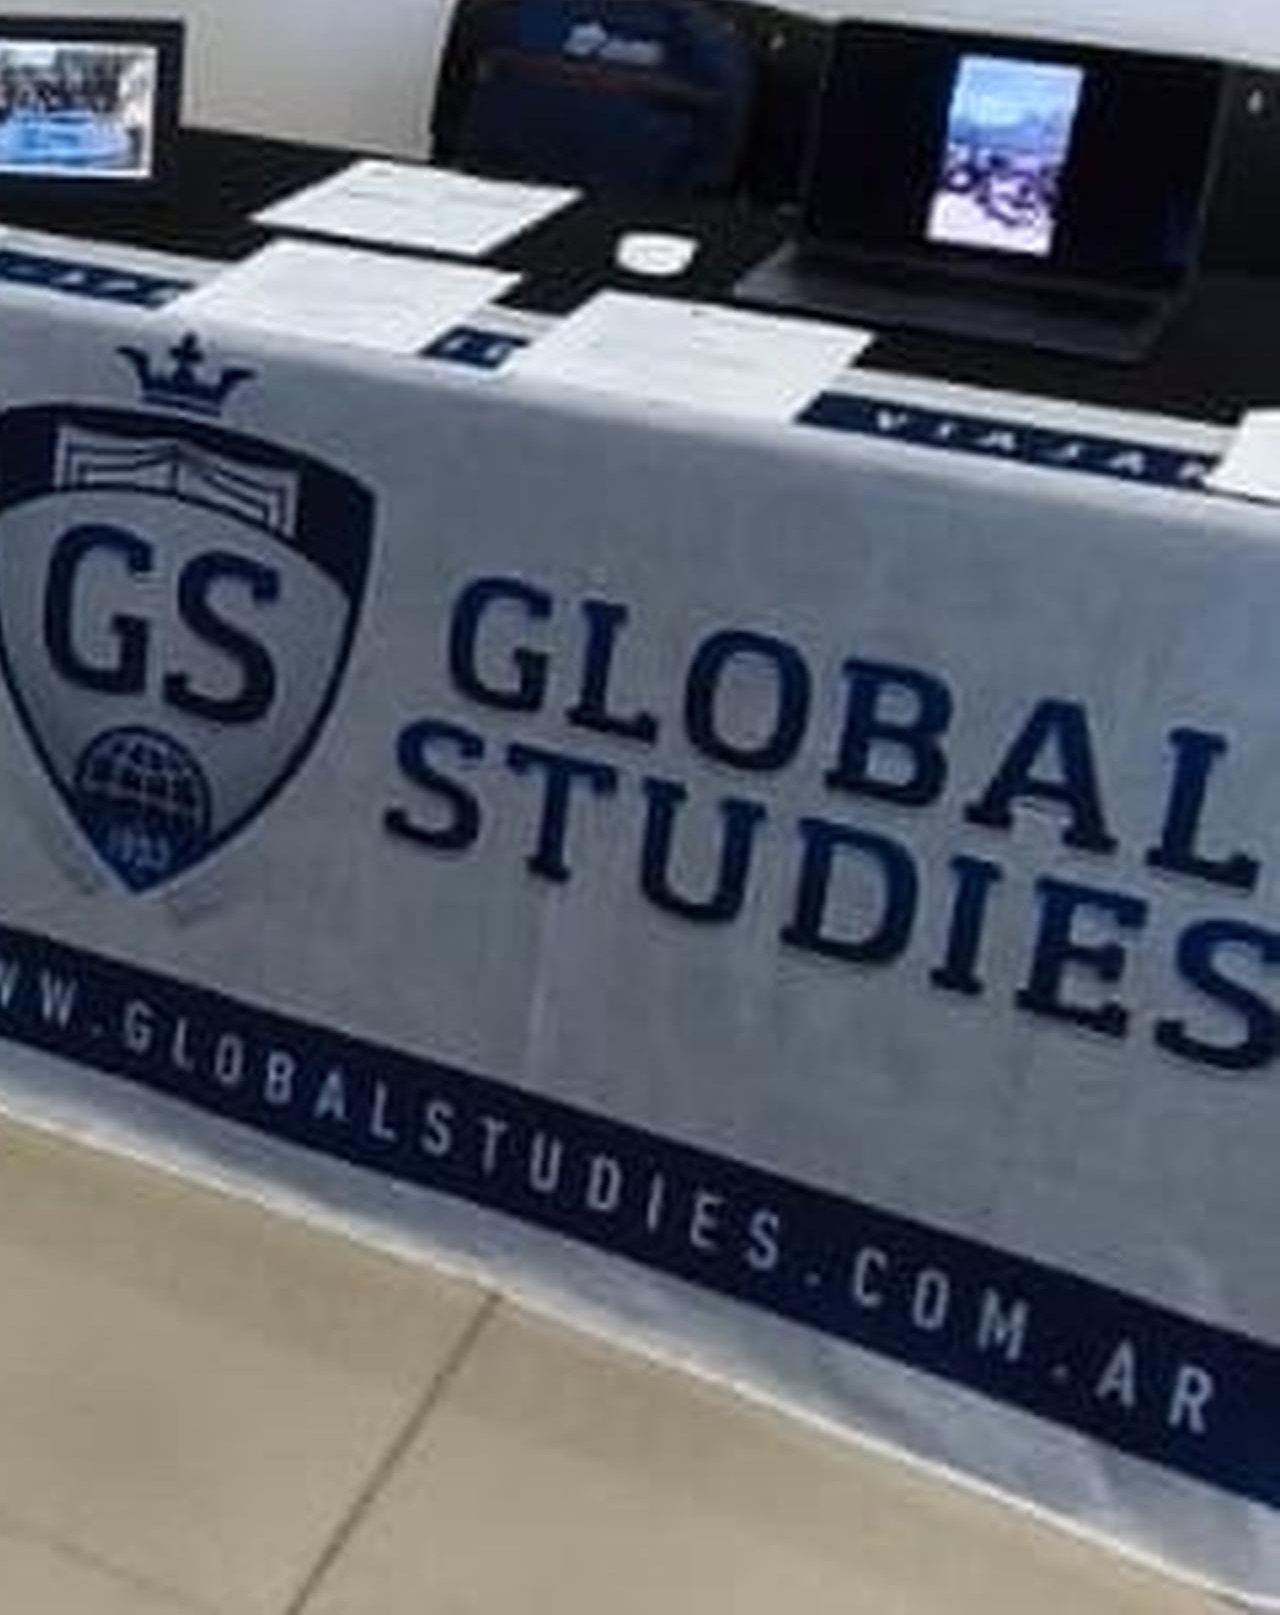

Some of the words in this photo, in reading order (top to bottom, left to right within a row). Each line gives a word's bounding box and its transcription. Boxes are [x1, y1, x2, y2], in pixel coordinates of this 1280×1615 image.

[41, 523, 282, 724] GS
[446, 575, 1261, 892] GLOBAL
[382, 717, 1280, 1073] STUDIES
